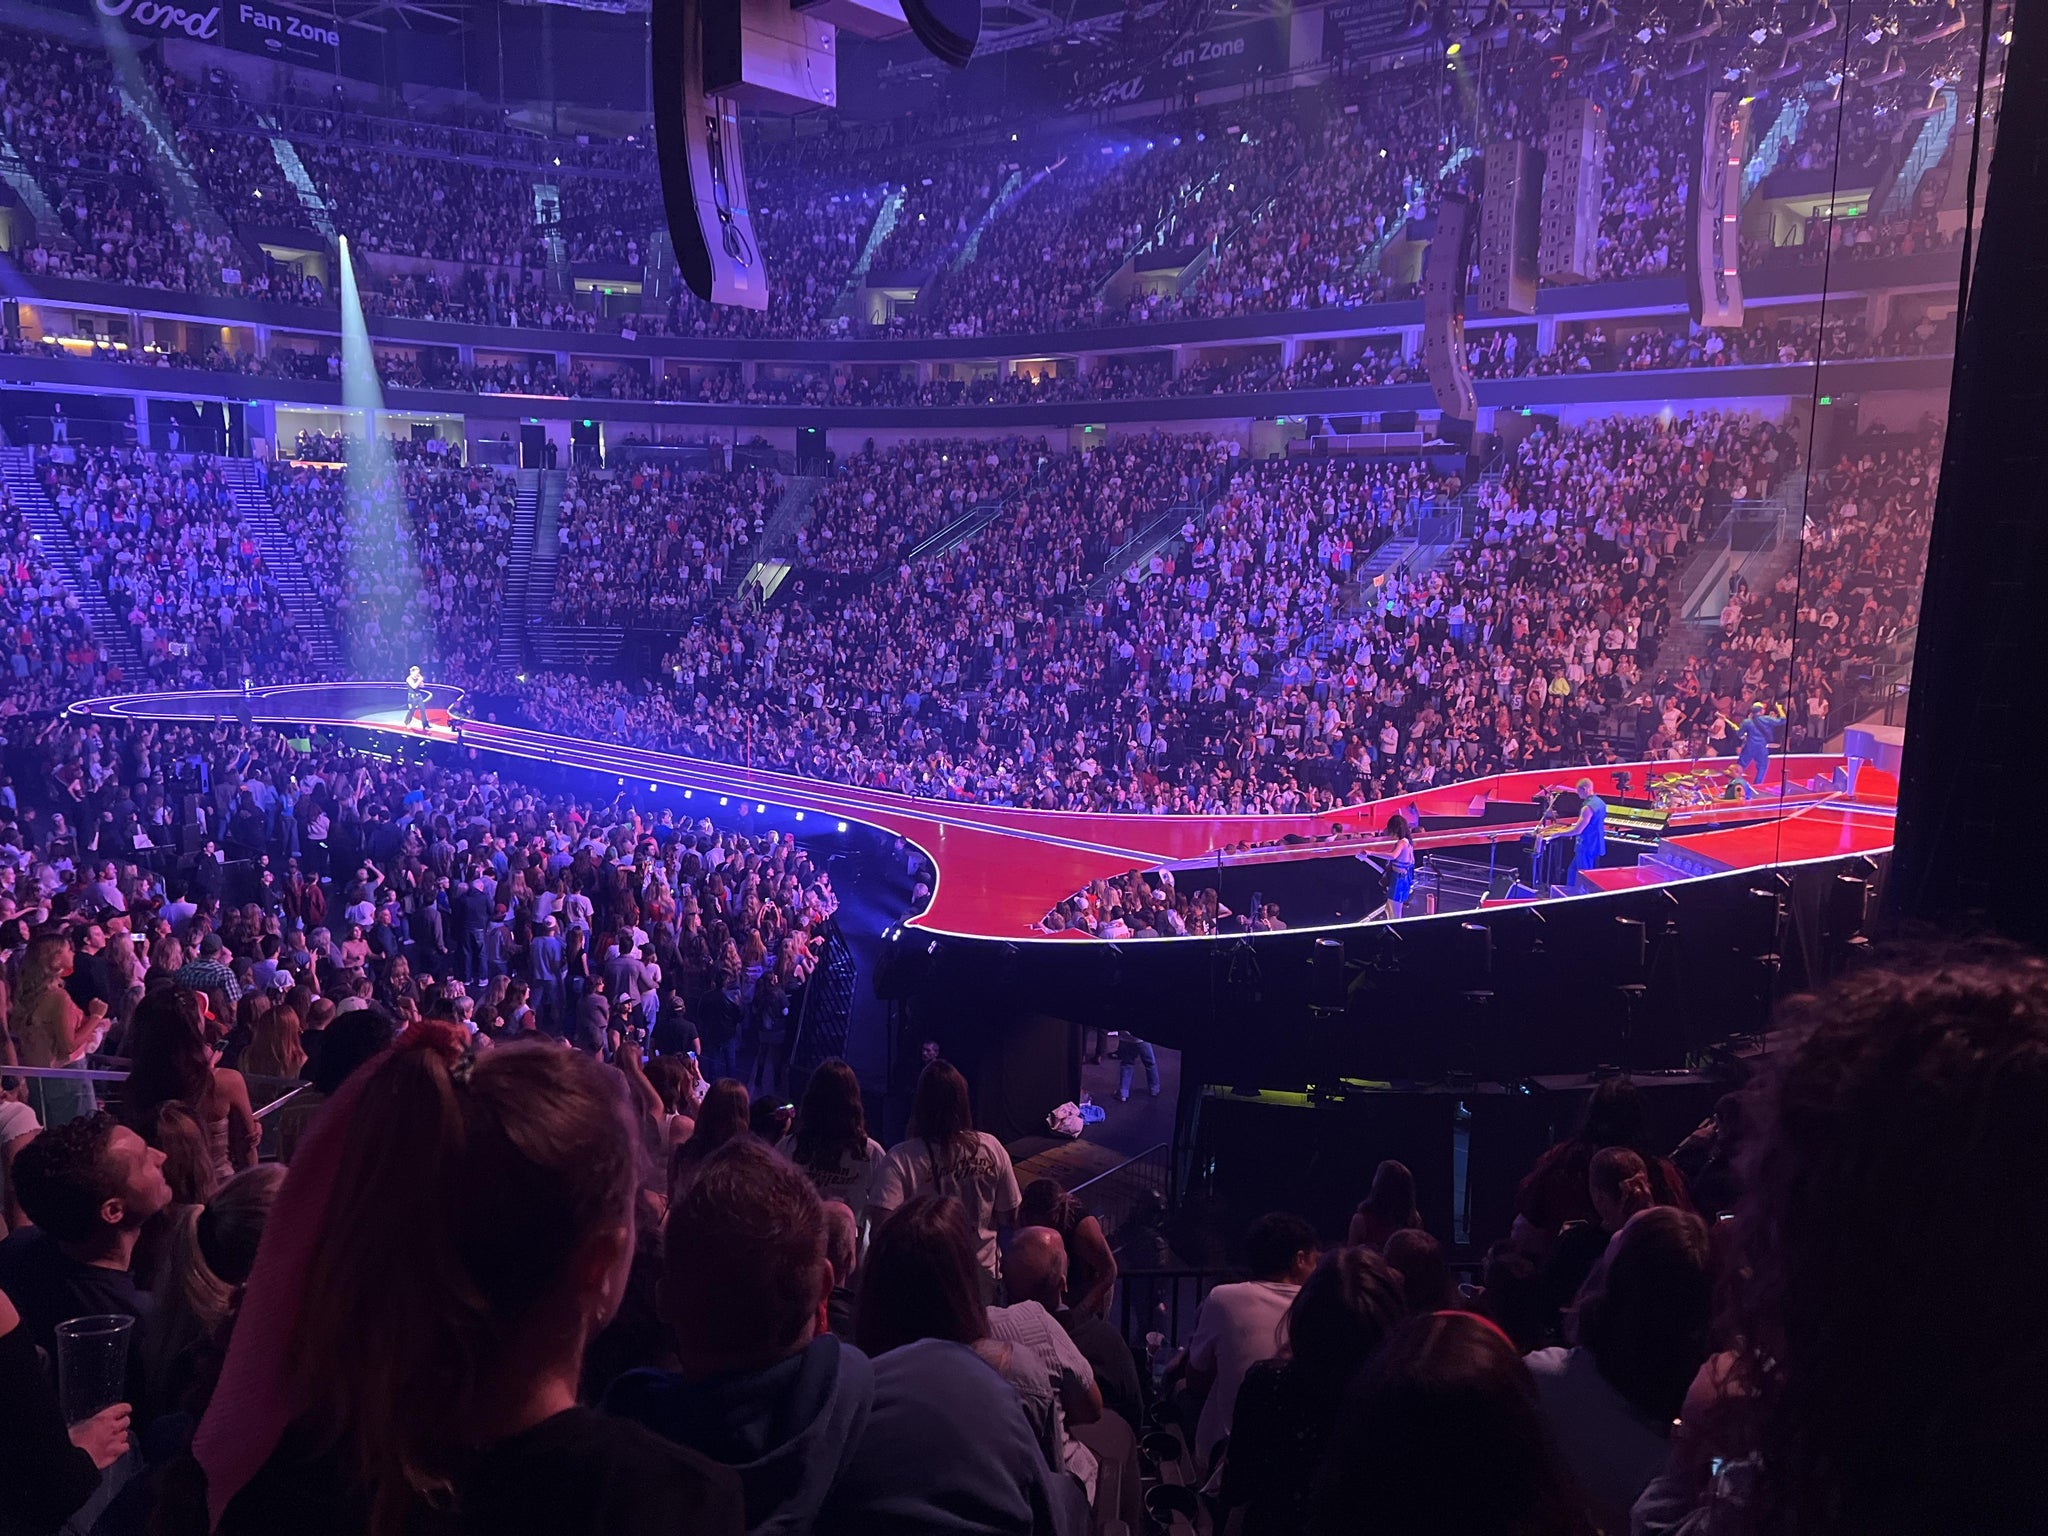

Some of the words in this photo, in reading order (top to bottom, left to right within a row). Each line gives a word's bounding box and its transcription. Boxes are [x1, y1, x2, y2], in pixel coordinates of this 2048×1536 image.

[97, 0, 220, 40] ord
[239, 4, 282, 33] Fan
[286, 16, 340, 47] Zone
[1198, 38, 1246, 62] Zone
